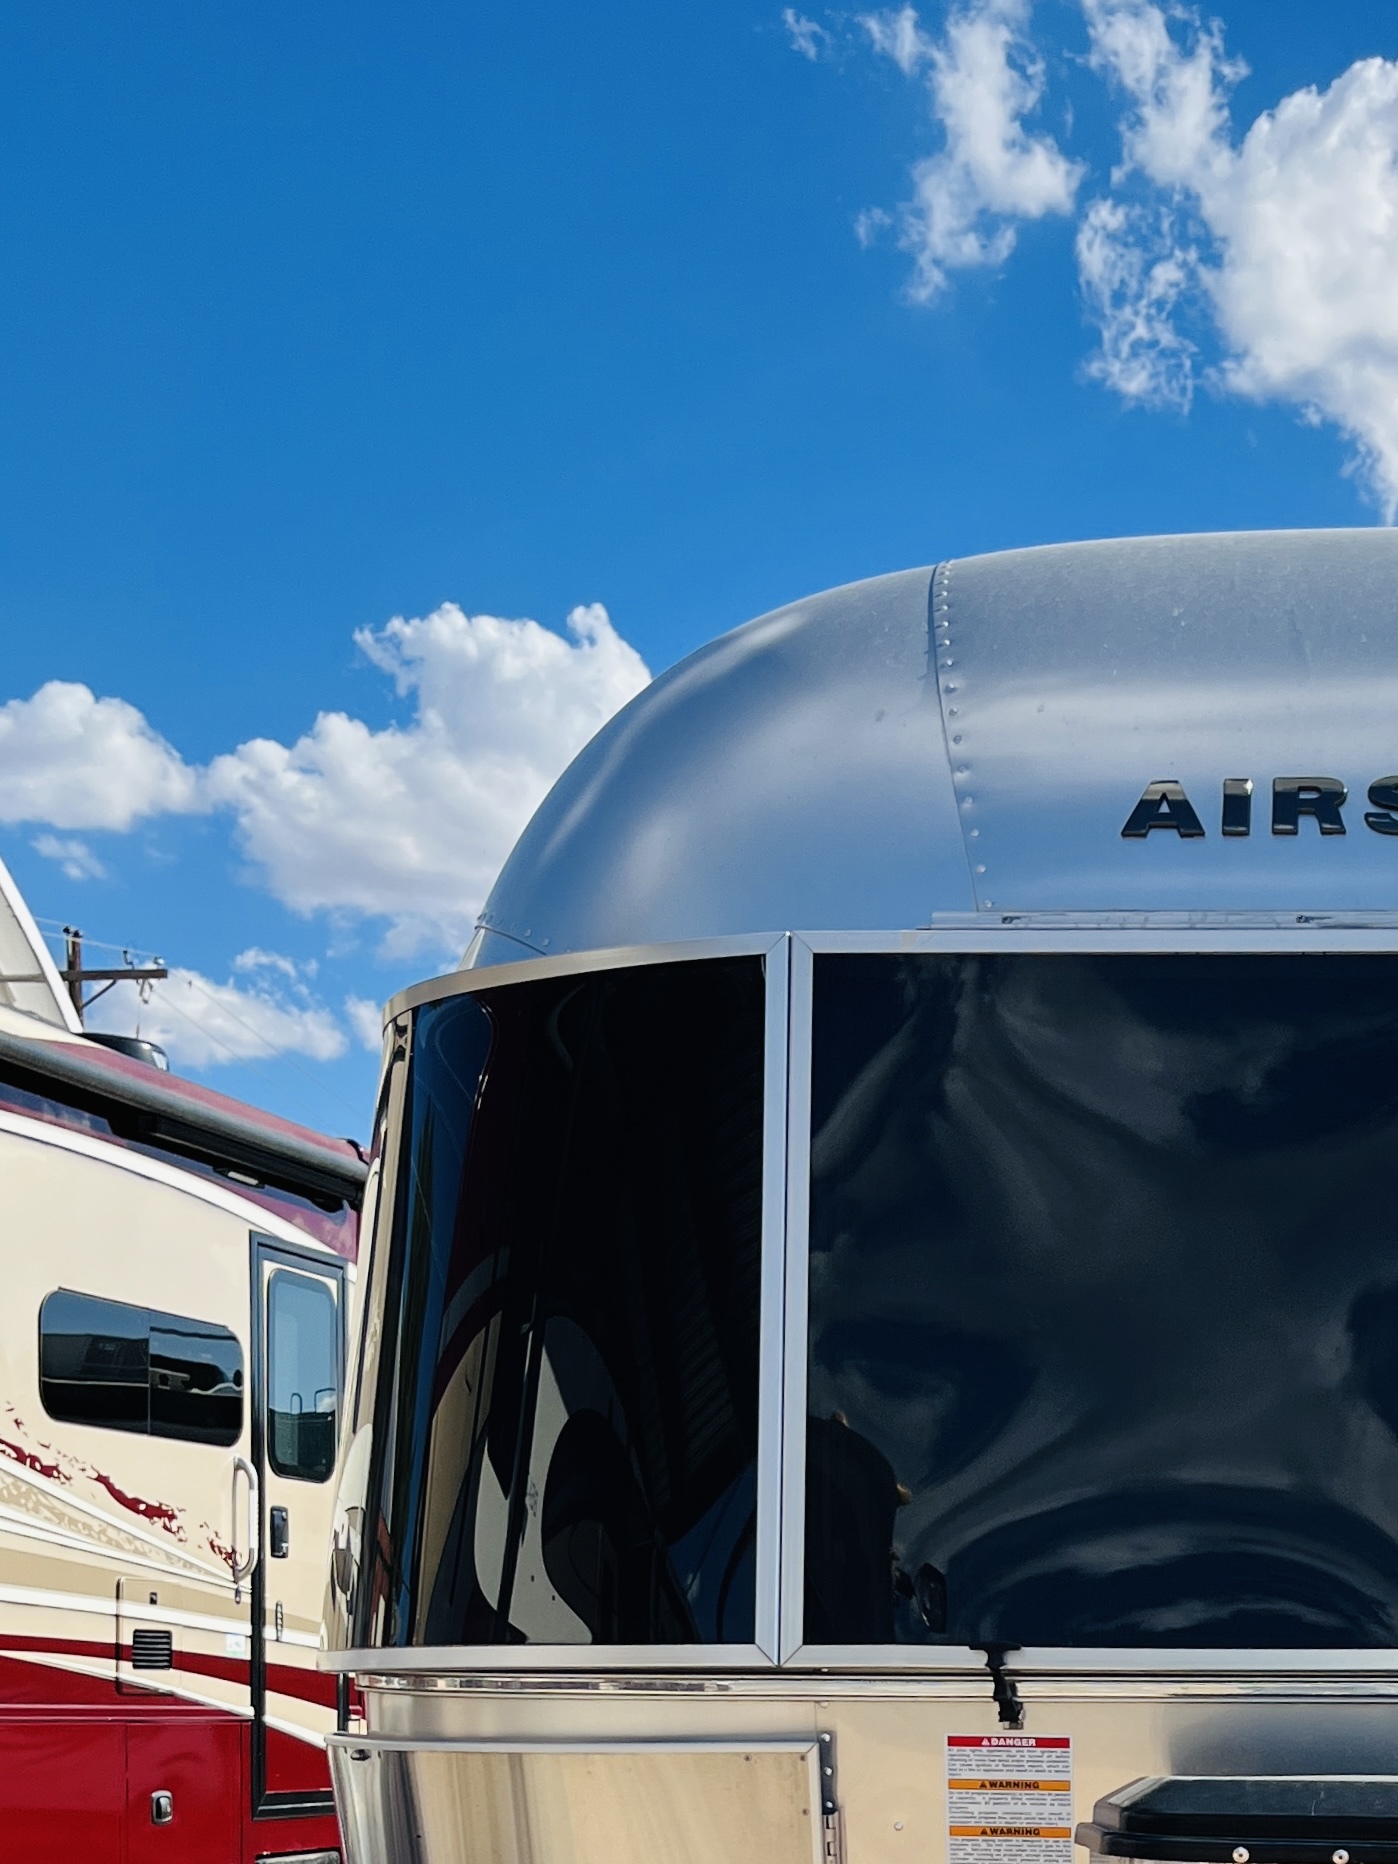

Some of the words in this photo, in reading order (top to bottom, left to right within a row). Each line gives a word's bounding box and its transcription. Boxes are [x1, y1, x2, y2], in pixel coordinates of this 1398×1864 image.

[991, 1737, 1036, 1746] DANGER
[989, 1780, 1039, 1790] WARNING
[989, 1827, 1040, 1837] WARNING
